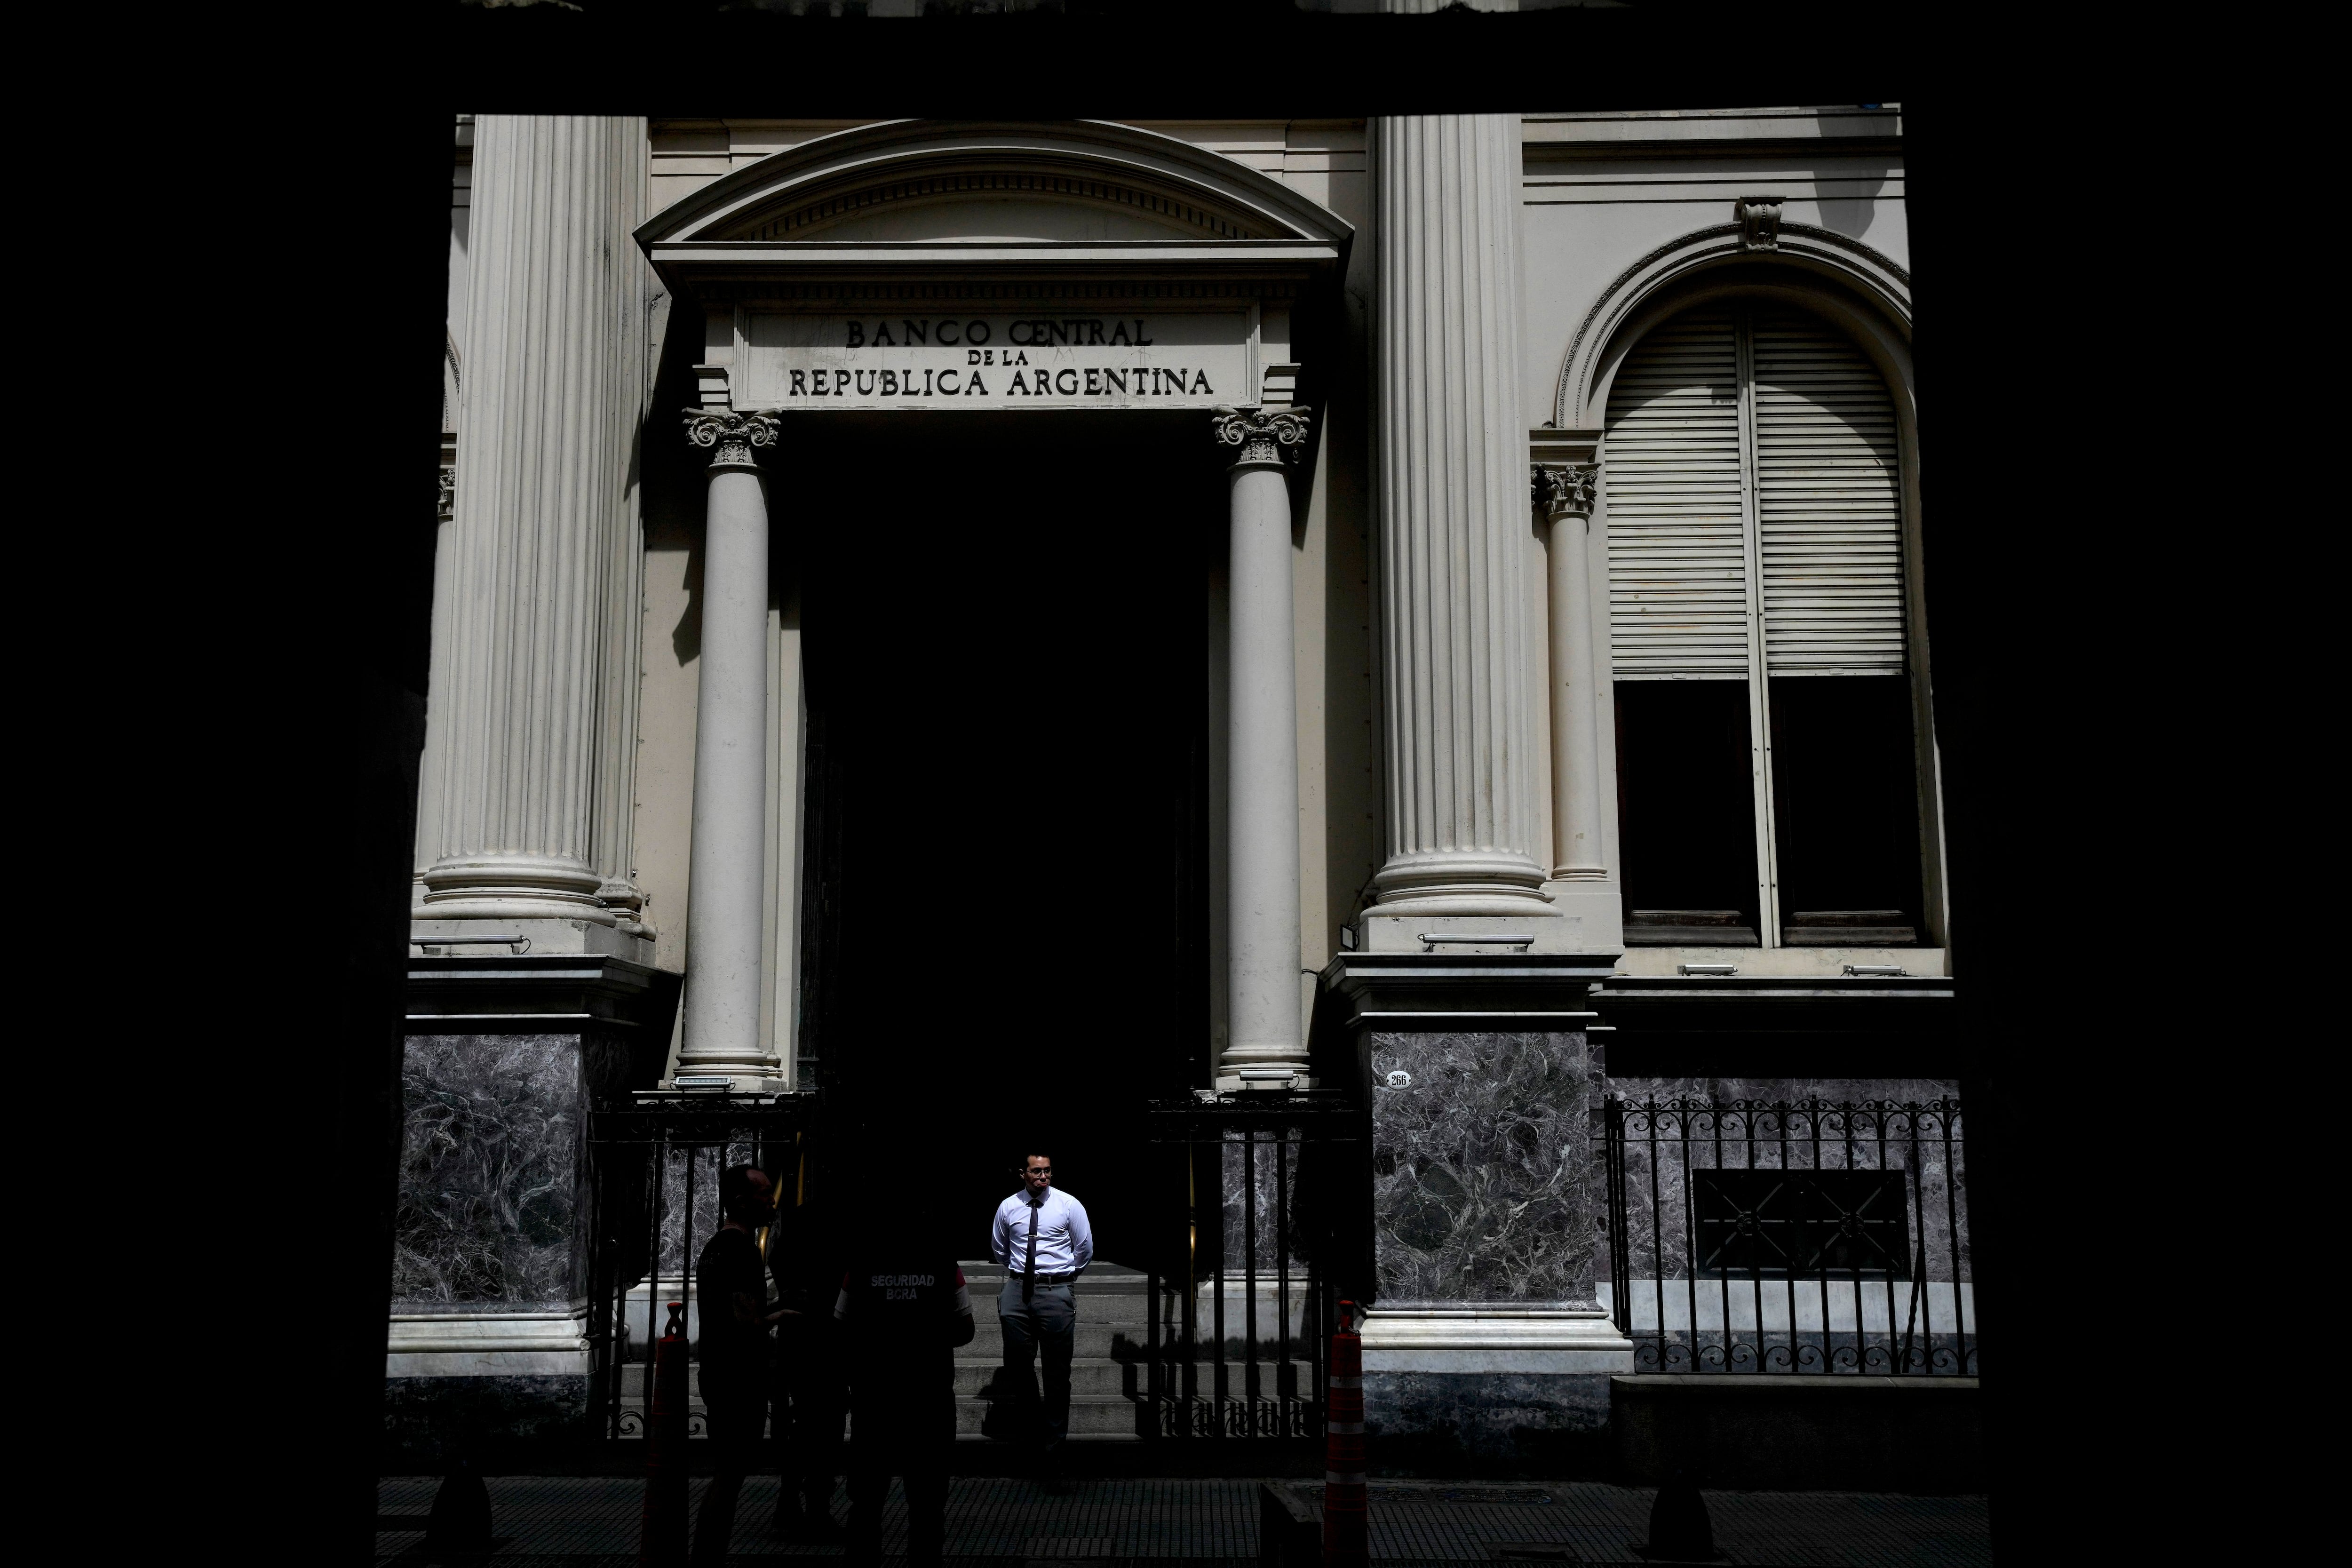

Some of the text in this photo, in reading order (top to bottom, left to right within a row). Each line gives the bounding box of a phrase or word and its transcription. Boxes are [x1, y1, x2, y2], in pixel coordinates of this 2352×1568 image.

[847, 319, 1153, 347] BANCO CENTRAL
[968, 350, 1028, 366] DE LA
[790, 368, 1213, 396] REPUBLICA ARGENTINA
[1391, 1075, 1406, 1086] 266
[871, 1274, 935, 1287] SEGURIDAD
[886, 1287, 918, 1300] BCRA
